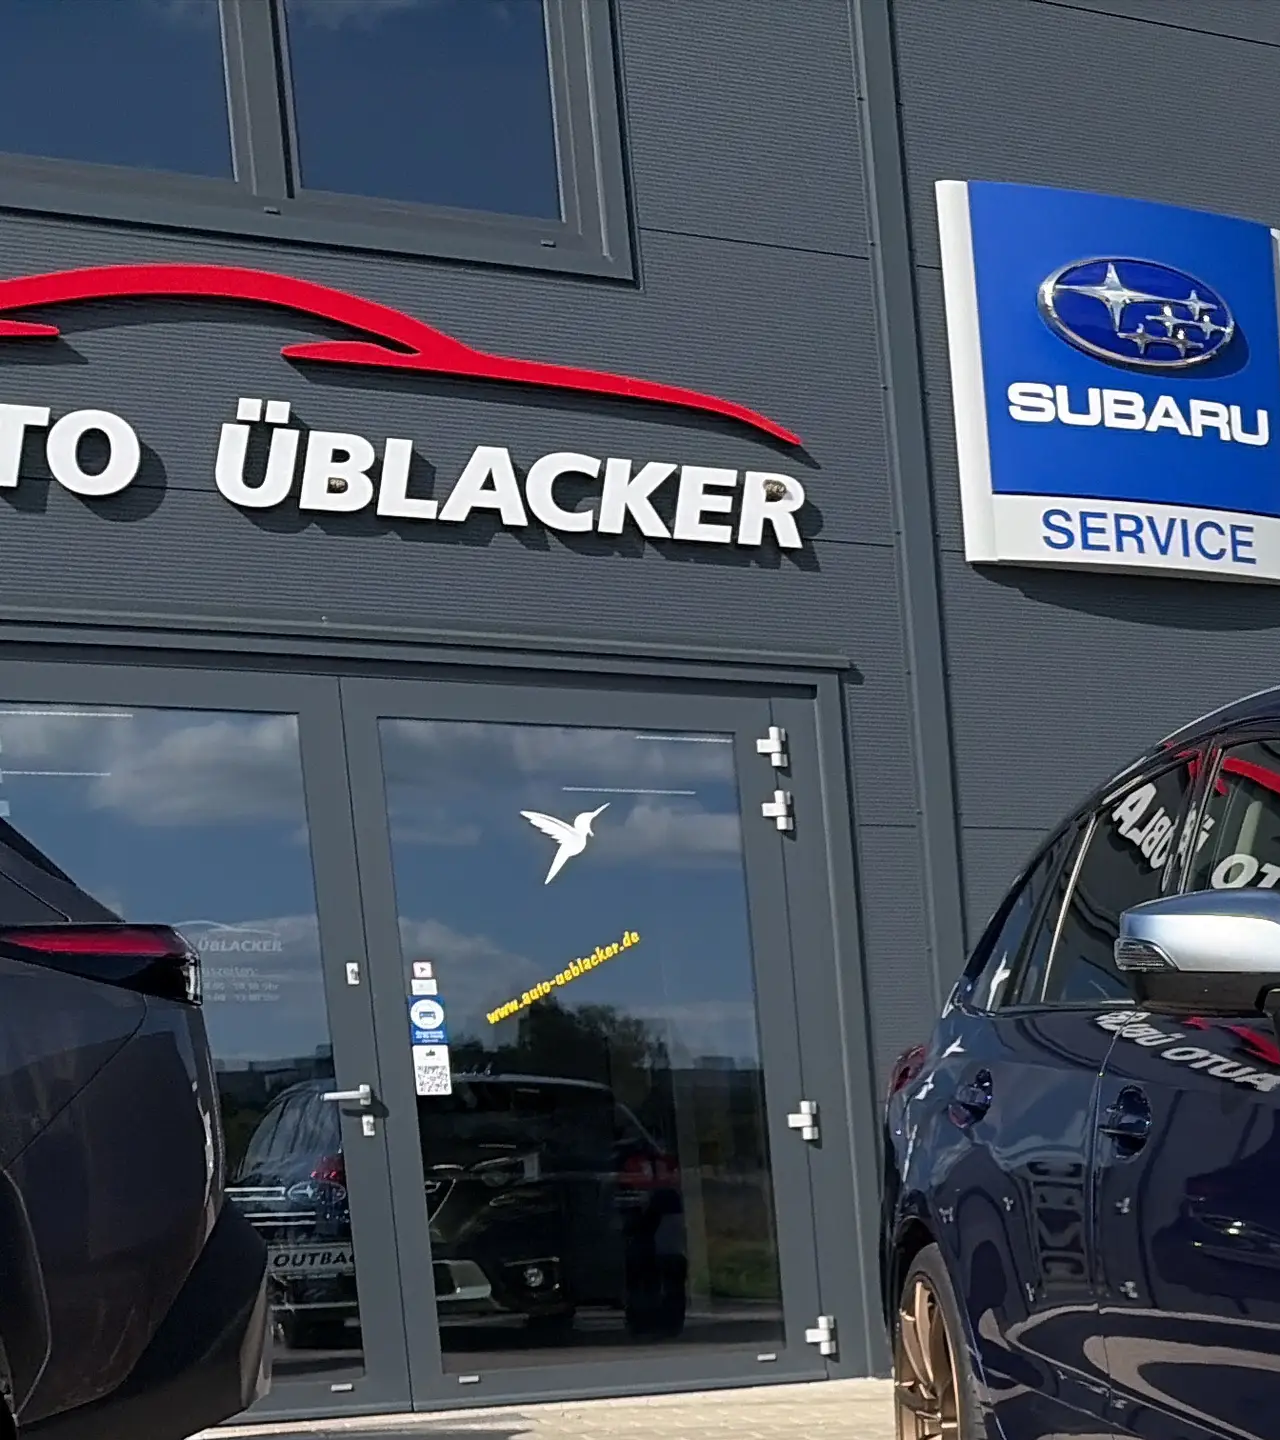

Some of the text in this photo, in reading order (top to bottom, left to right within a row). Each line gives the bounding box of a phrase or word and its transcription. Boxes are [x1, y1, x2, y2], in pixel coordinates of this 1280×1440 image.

[1007, 382, 1269, 446] SUBARU
[0, 397, 805, 549] TO ÜBLACKER
[1042, 509, 1257, 565] SERVICE
[486, 930, 641, 1025] www.auto-ueblacker.de
